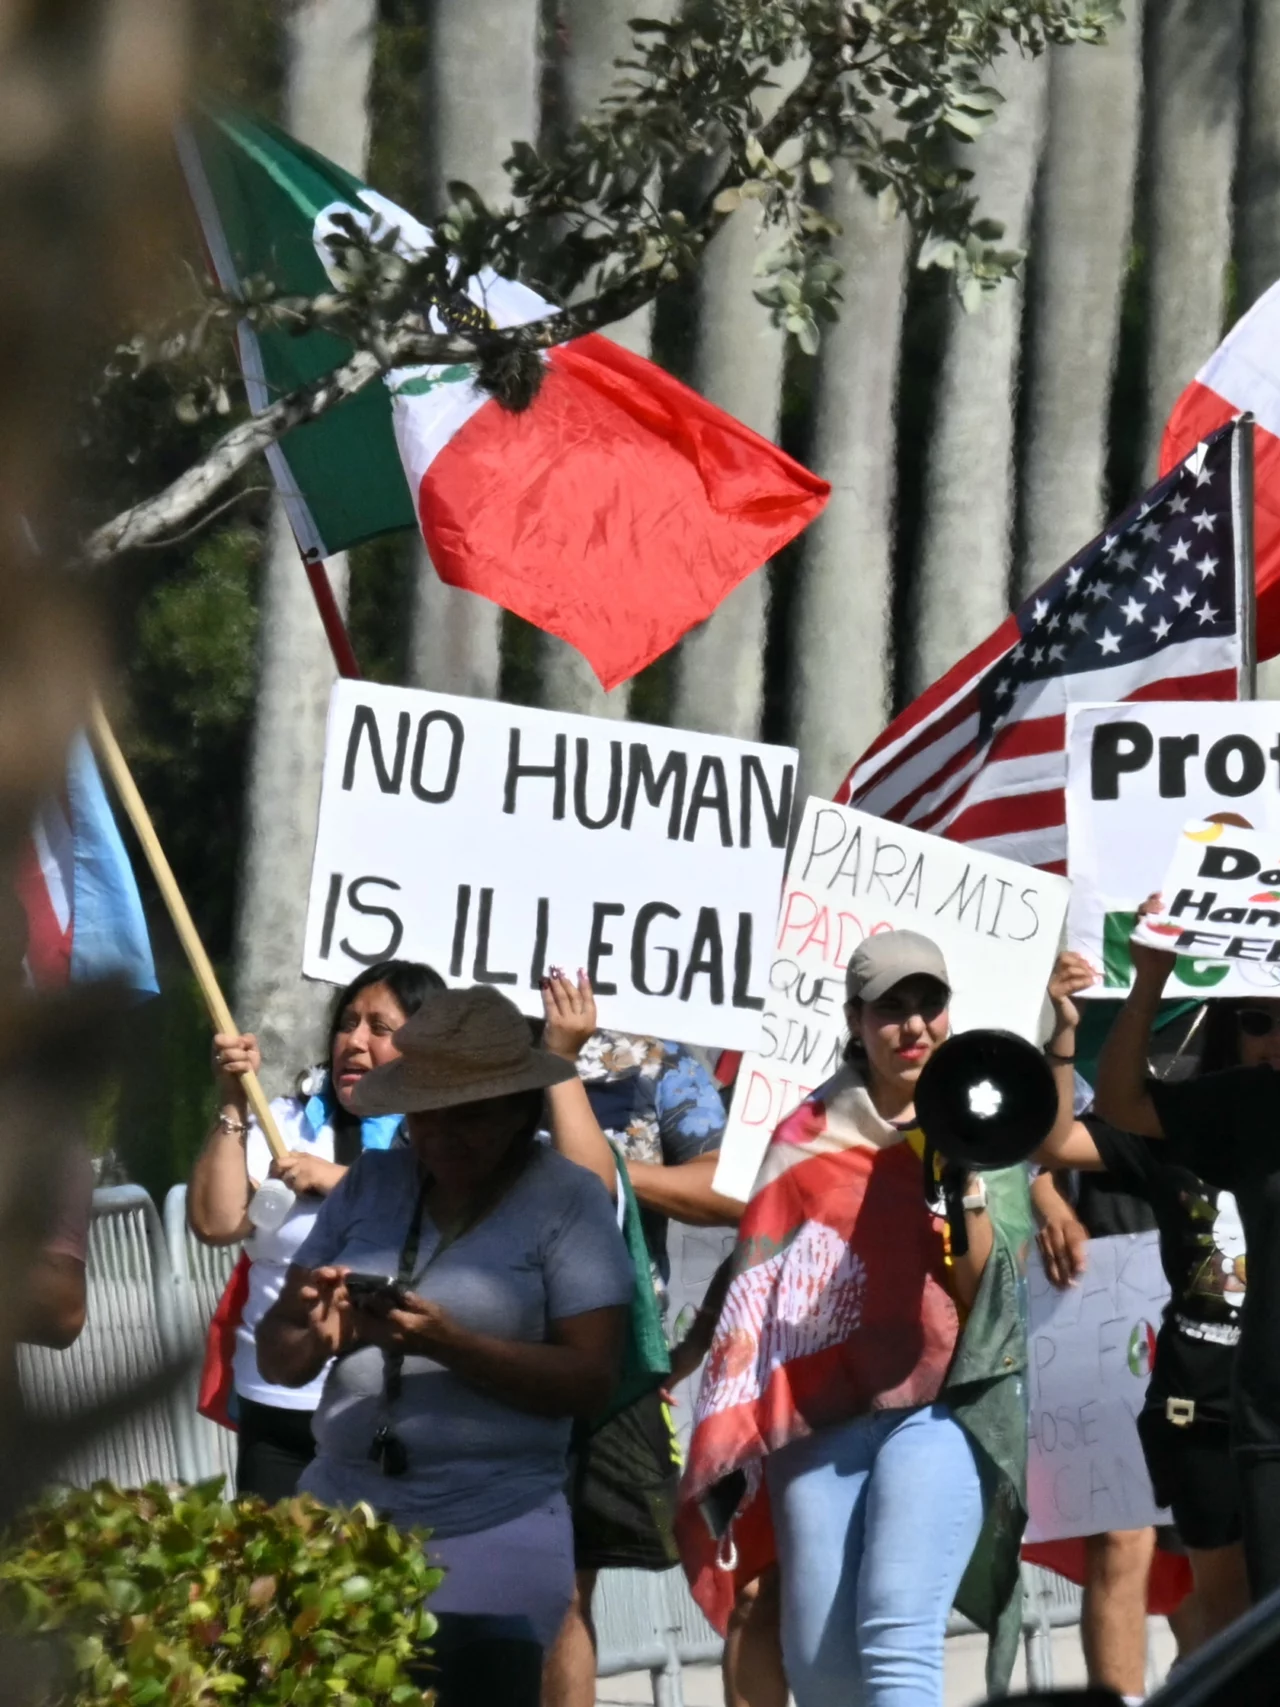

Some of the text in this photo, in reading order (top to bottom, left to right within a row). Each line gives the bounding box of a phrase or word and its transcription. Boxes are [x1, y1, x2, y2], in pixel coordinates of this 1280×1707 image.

[341, 704, 794, 849] NO HUMAN
[777, 890, 894, 971] PAD
[801, 808, 1040, 941] PARA MIS
[319, 873, 766, 1012] IS ILLEGAL
[758, 1011, 822, 1066] SIN
